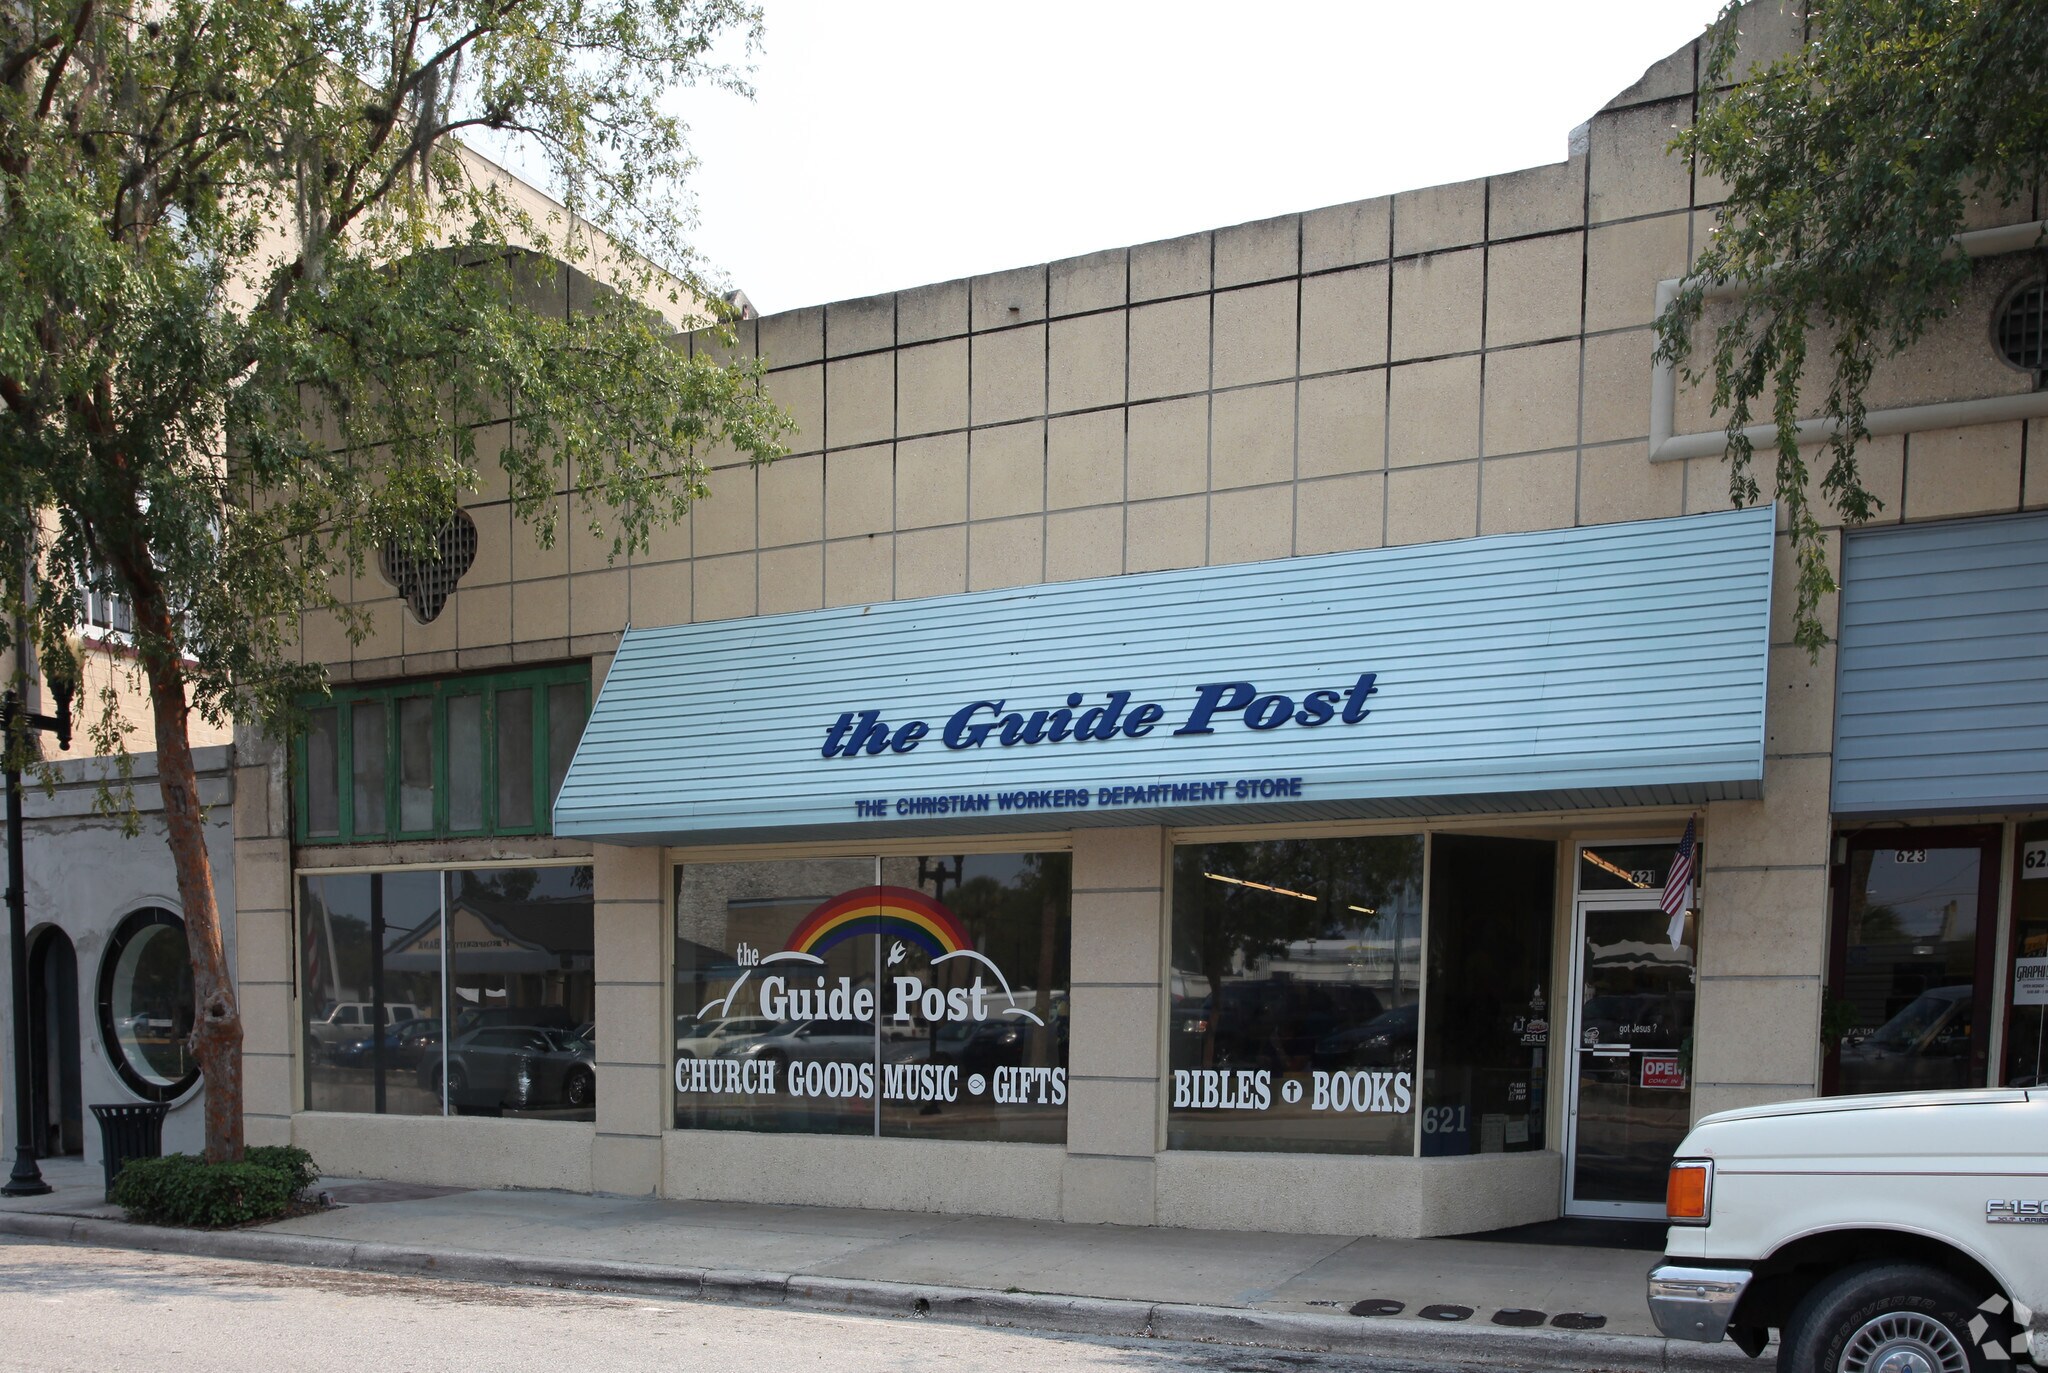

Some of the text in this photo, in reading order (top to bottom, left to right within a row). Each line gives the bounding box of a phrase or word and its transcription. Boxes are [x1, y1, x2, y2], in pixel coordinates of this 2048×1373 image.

[820, 673, 1378, 759] the Guide Post
[855, 777, 1303, 817] THE CHRISTIAN WORKERS DEPARTMENT STORE
[1896, 849, 1926, 863] 623
[2025, 850, 2048, 869] 62
[1632, 870, 1655, 884] 621
[736, 942, 759, 967] the
[759, 975, 989, 1022] Guide Post
[1520, 1034, 1547, 1042] JESUS
[1619, 1024, 1630, 1036] got
[1632, 1024, 1651, 1034] Jesus
[675, 1058, 875, 1099] CHURCH GOODS
[883, 1063, 1067, 1105] MUSIC GIFTS
[1173, 1069, 1411, 1114] BIBLES BOOKS
[1422, 1105, 1467, 1134] 621
